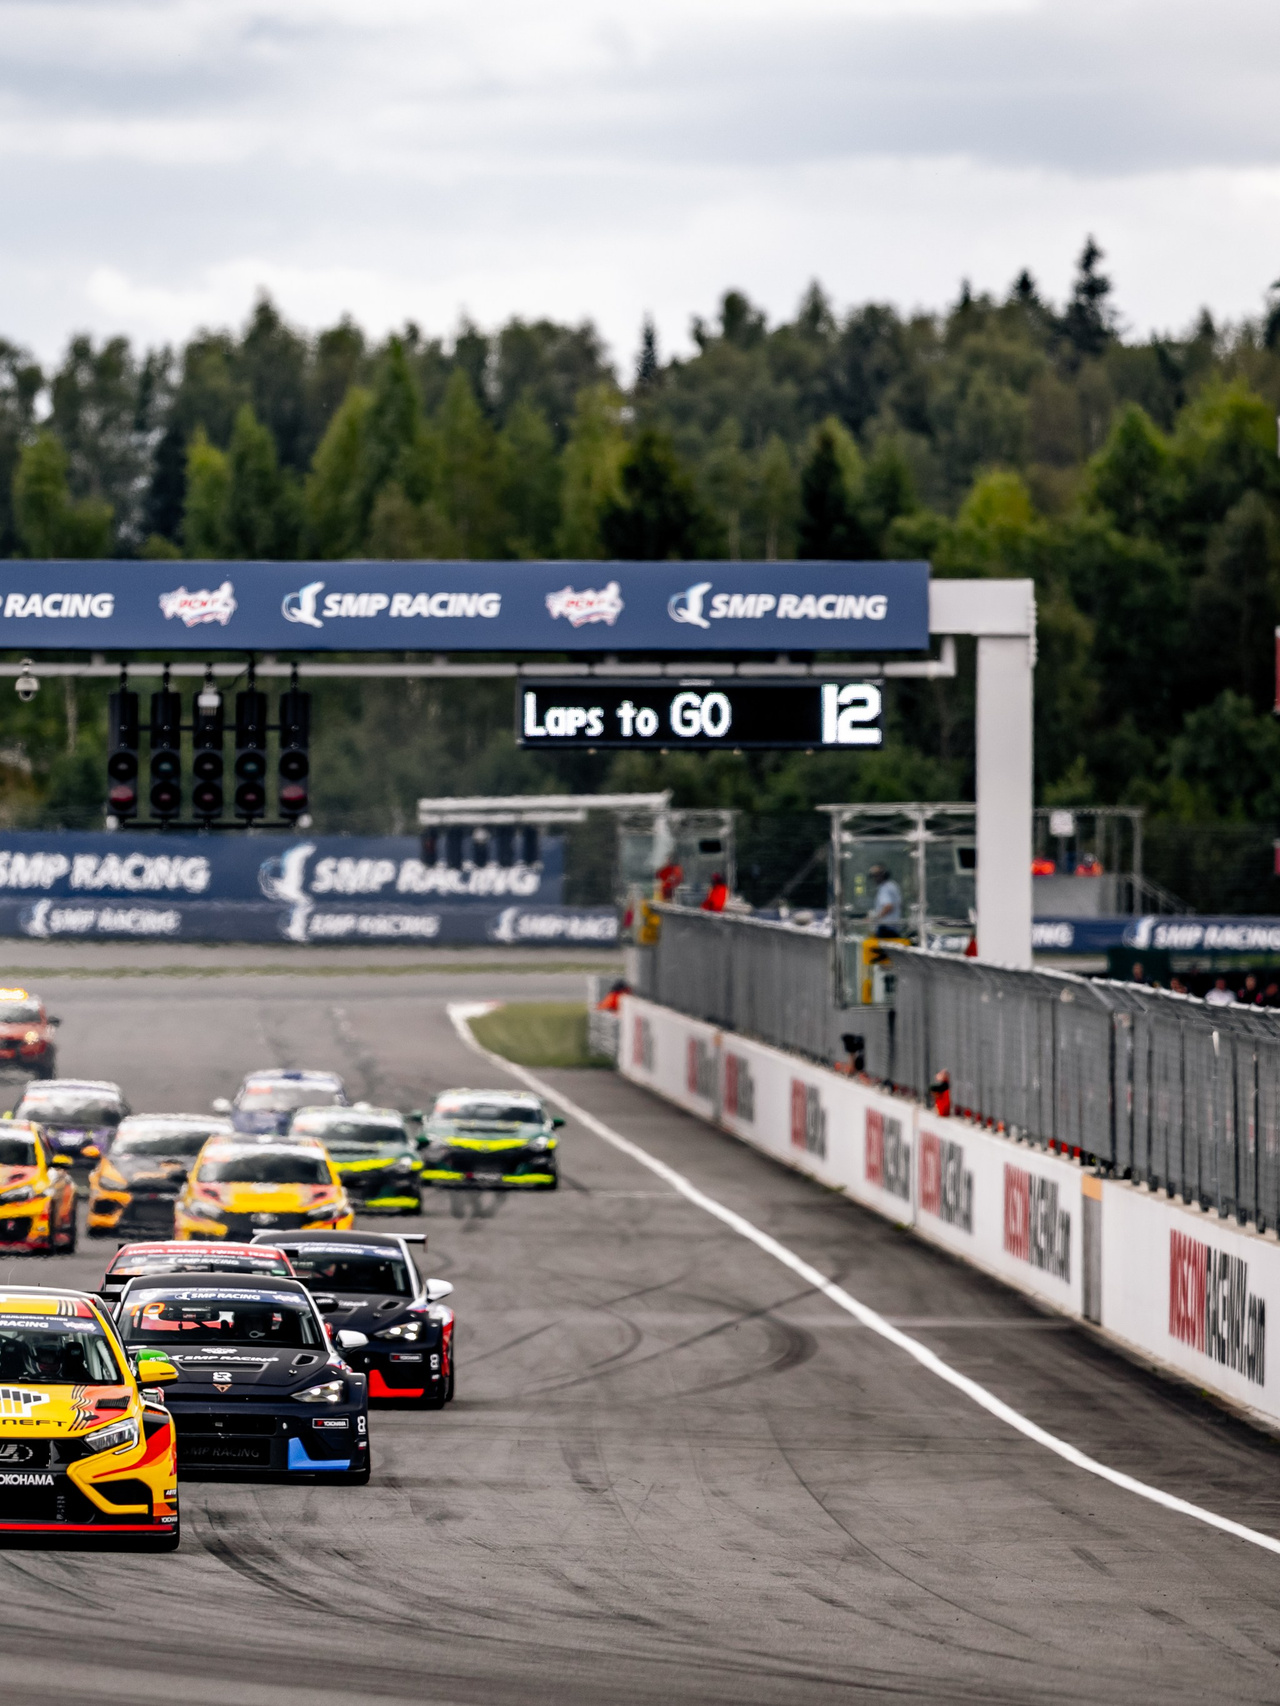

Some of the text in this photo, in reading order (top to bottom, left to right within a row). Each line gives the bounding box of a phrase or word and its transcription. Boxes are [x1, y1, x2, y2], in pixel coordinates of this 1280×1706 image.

[3, 593, 114, 618] RACING
[322, 593, 501, 618] SMP RACING
[709, 593, 887, 620] SMP RACING
[524, 683, 882, 744] Laps to GO 12
[70, 852, 211, 893] RACING
[311, 857, 541, 895] SMP RACING
[127, 1302, 166, 1316] 10
